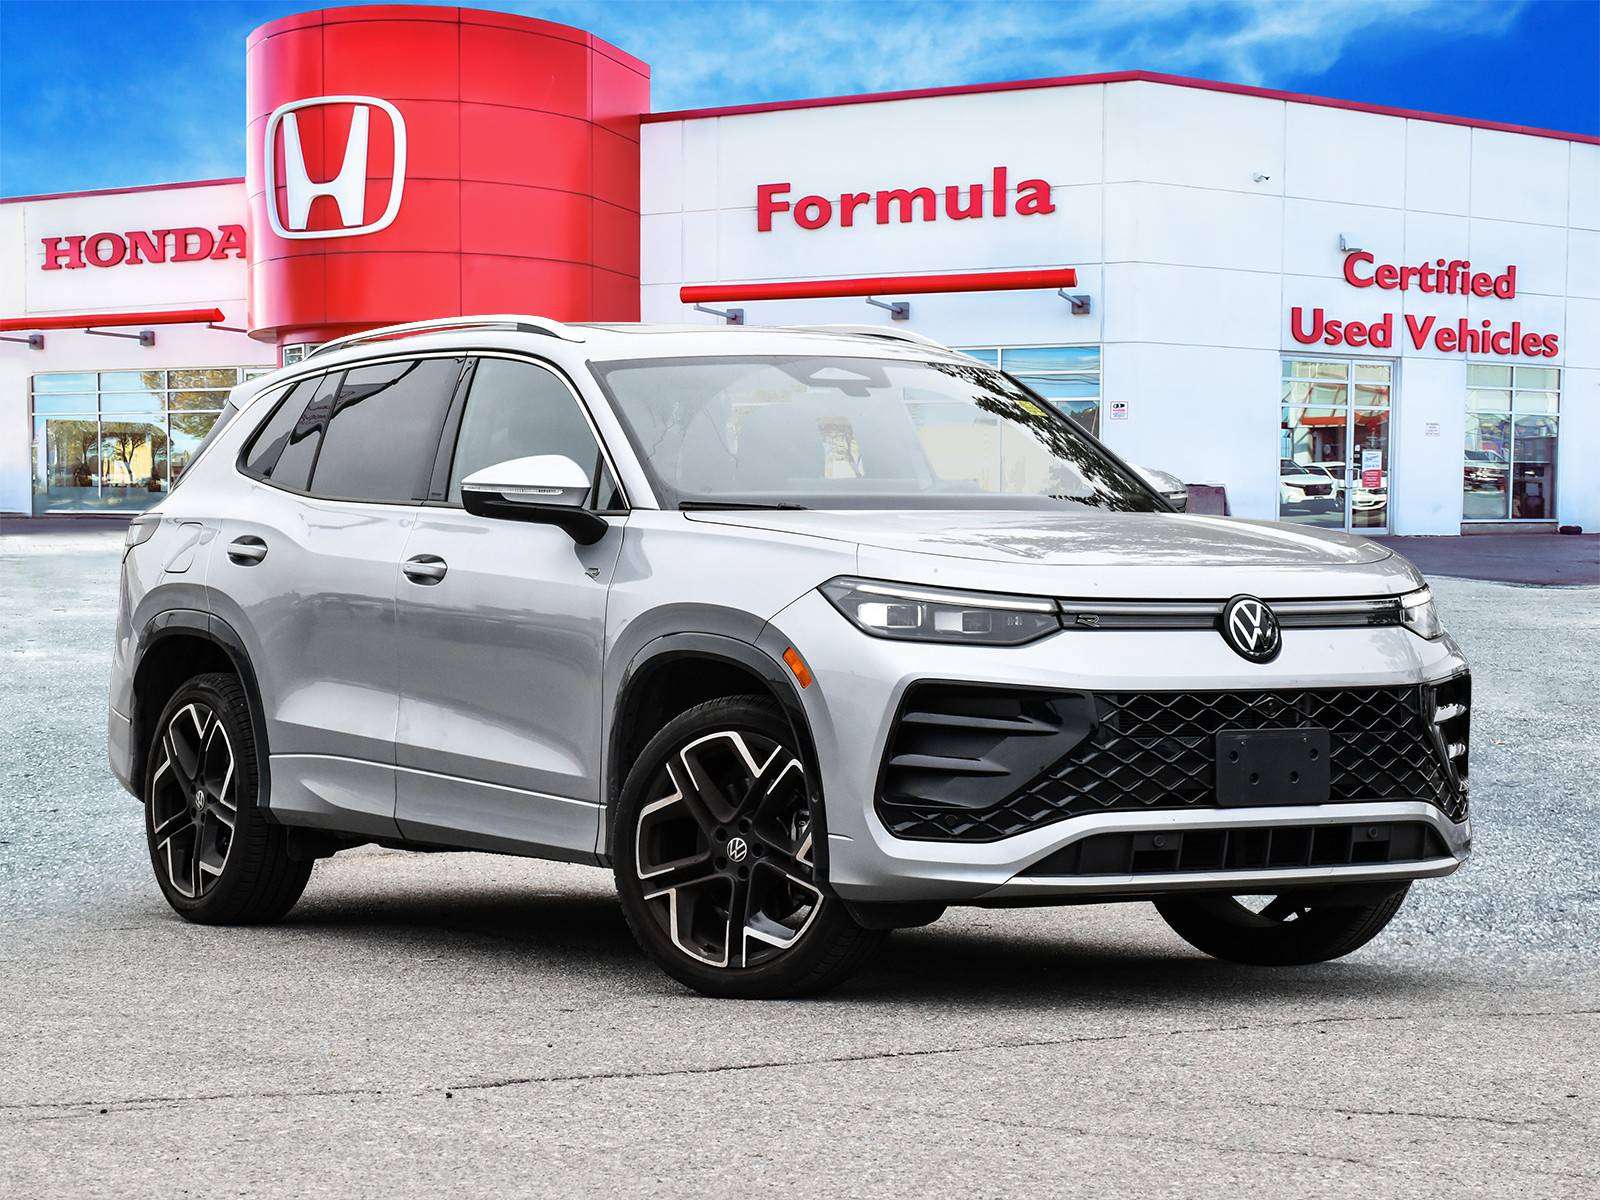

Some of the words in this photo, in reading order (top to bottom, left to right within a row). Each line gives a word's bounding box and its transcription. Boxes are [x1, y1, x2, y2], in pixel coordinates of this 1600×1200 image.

[757, 166, 1056, 233] Formula
[41, 224, 246, 271] HONDA
[1343, 251, 1517, 300] Certified
[1291, 307, 1393, 348] Used
[1404, 314, 1559, 358] Vehicles
